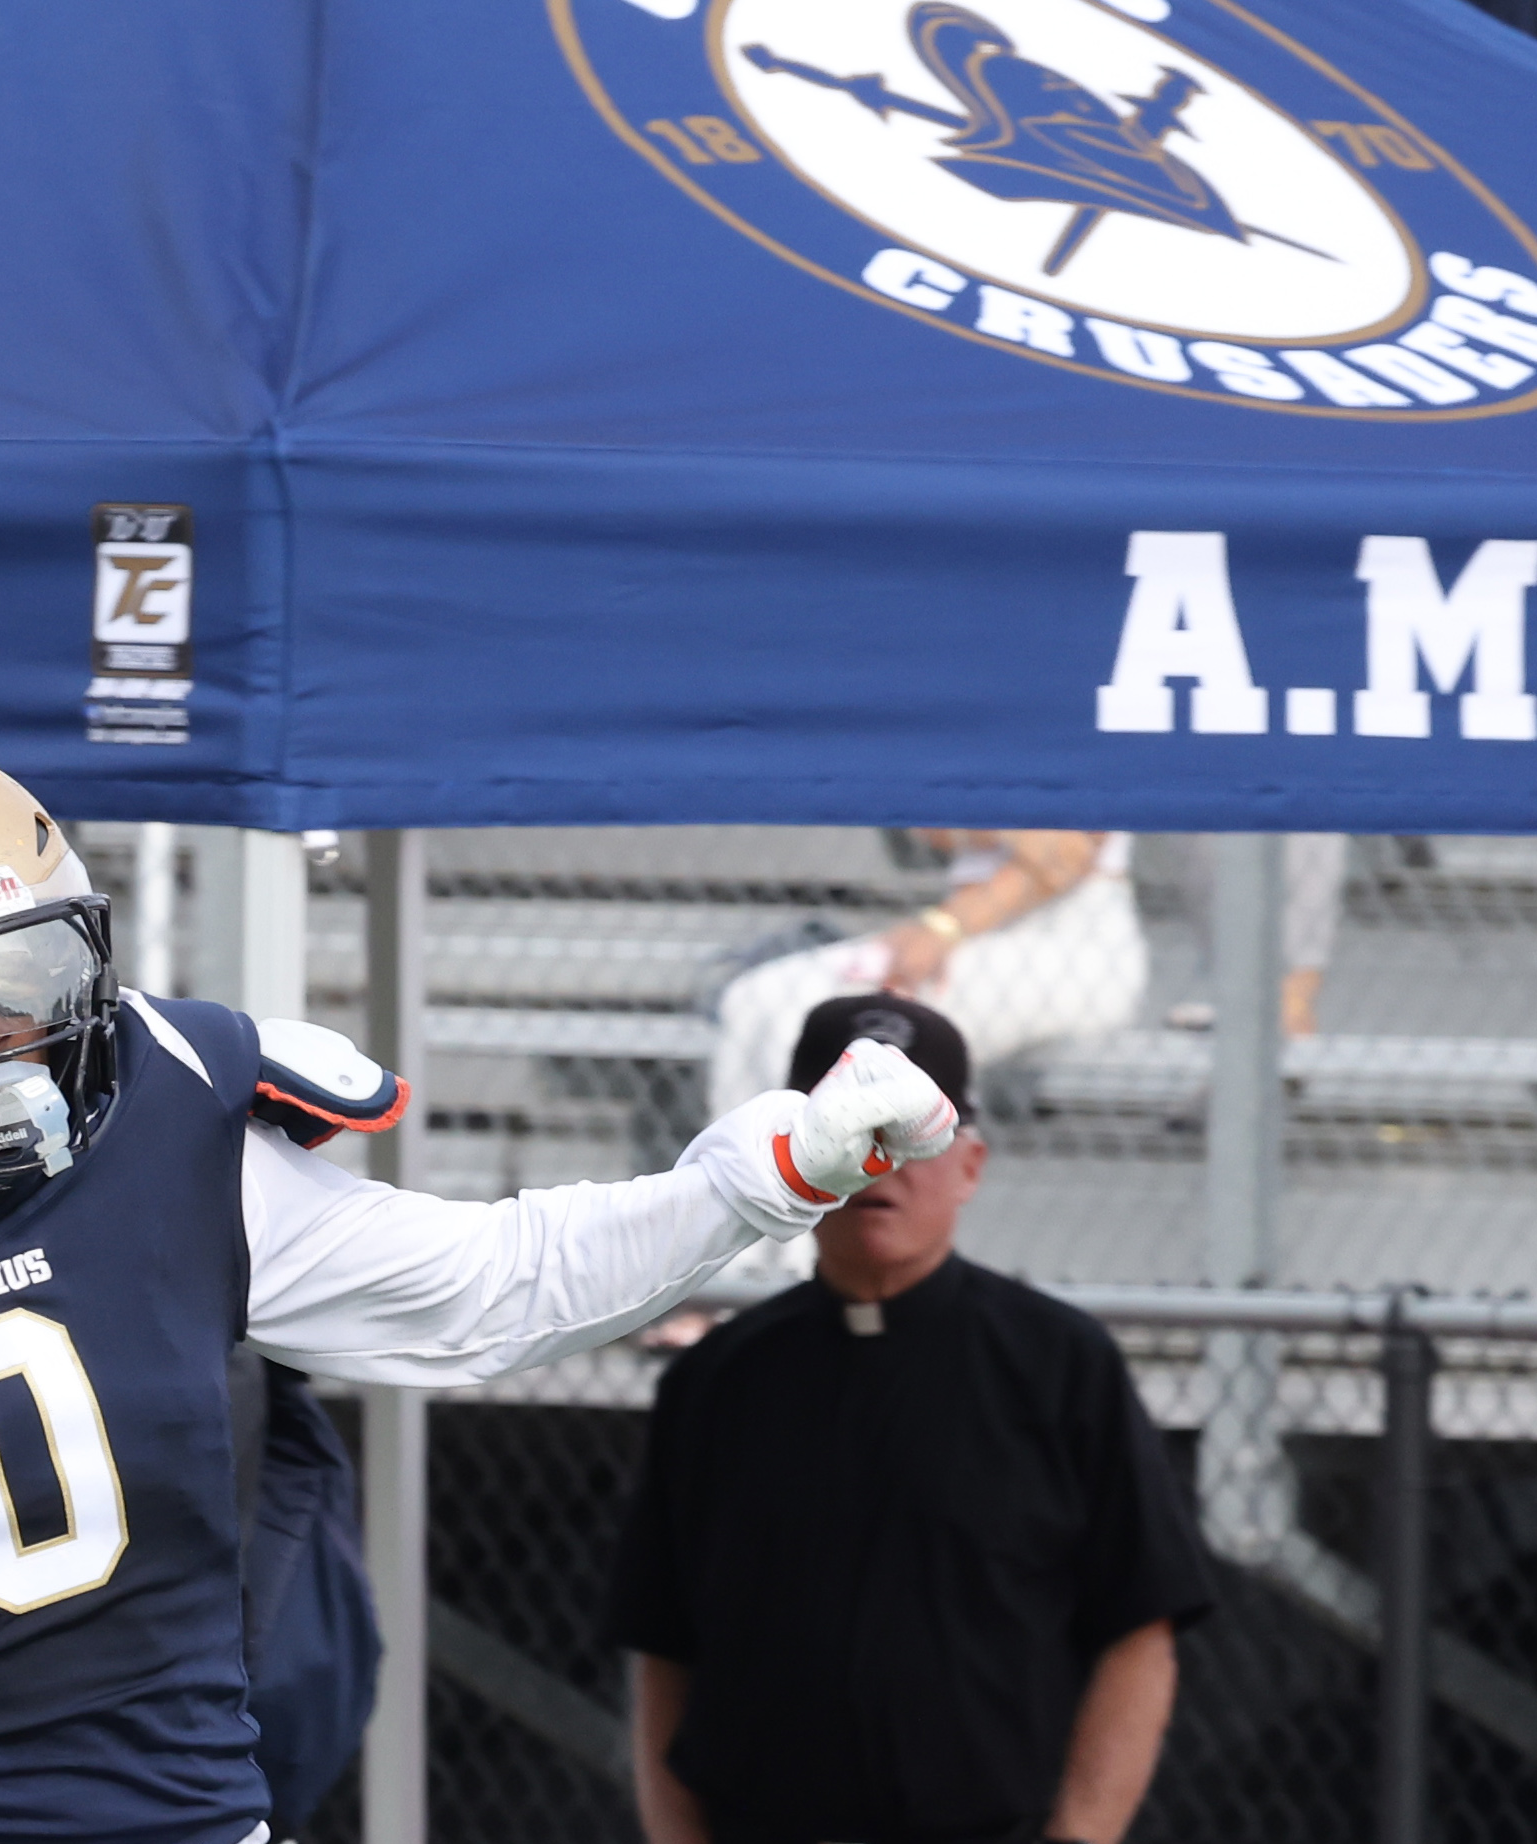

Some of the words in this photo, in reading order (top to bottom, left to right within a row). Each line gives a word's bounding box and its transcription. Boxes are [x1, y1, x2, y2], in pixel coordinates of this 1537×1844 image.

[645, 114, 763, 165] 18
[1313, 120, 1435, 170] 70
[861, 248, 1537, 407] CRUSADERS
